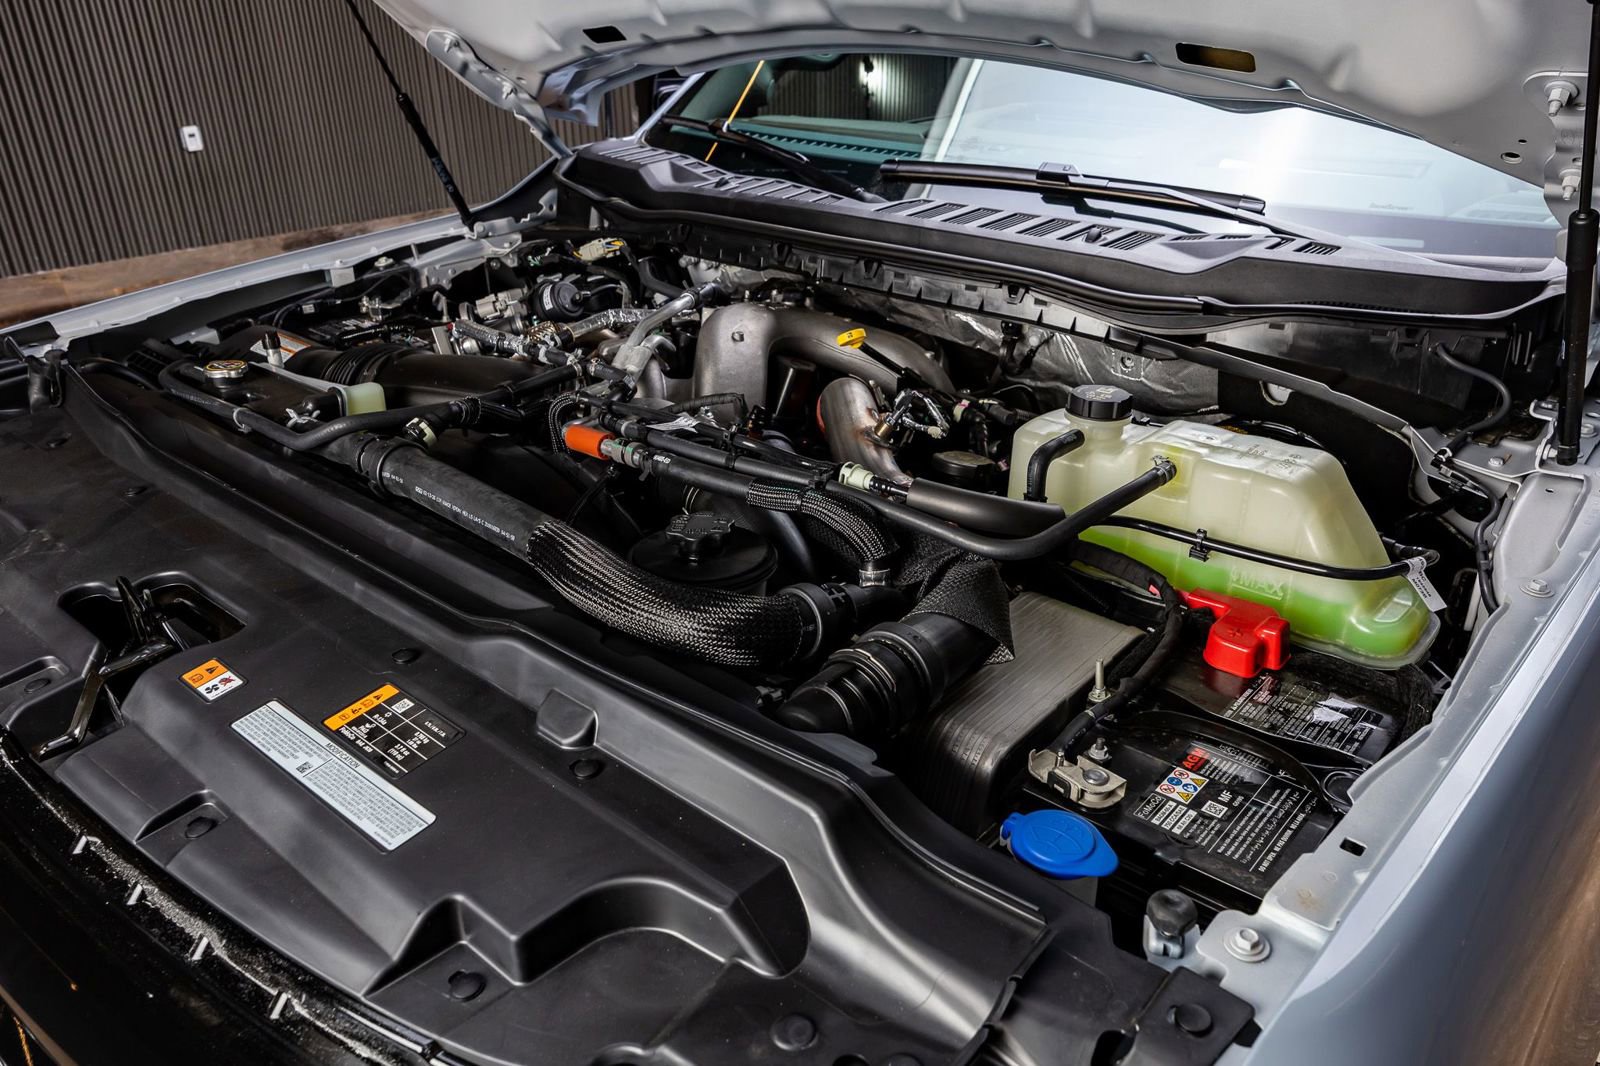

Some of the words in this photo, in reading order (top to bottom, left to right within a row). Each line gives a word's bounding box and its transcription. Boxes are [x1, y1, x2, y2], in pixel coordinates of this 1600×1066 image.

[326, 742, 360, 768] MODIFICATION
[1183, 748, 1206, 769] AGM
[1138, 796, 1162, 818] FoMoCo
[1218, 790, 1233, 803] MF
